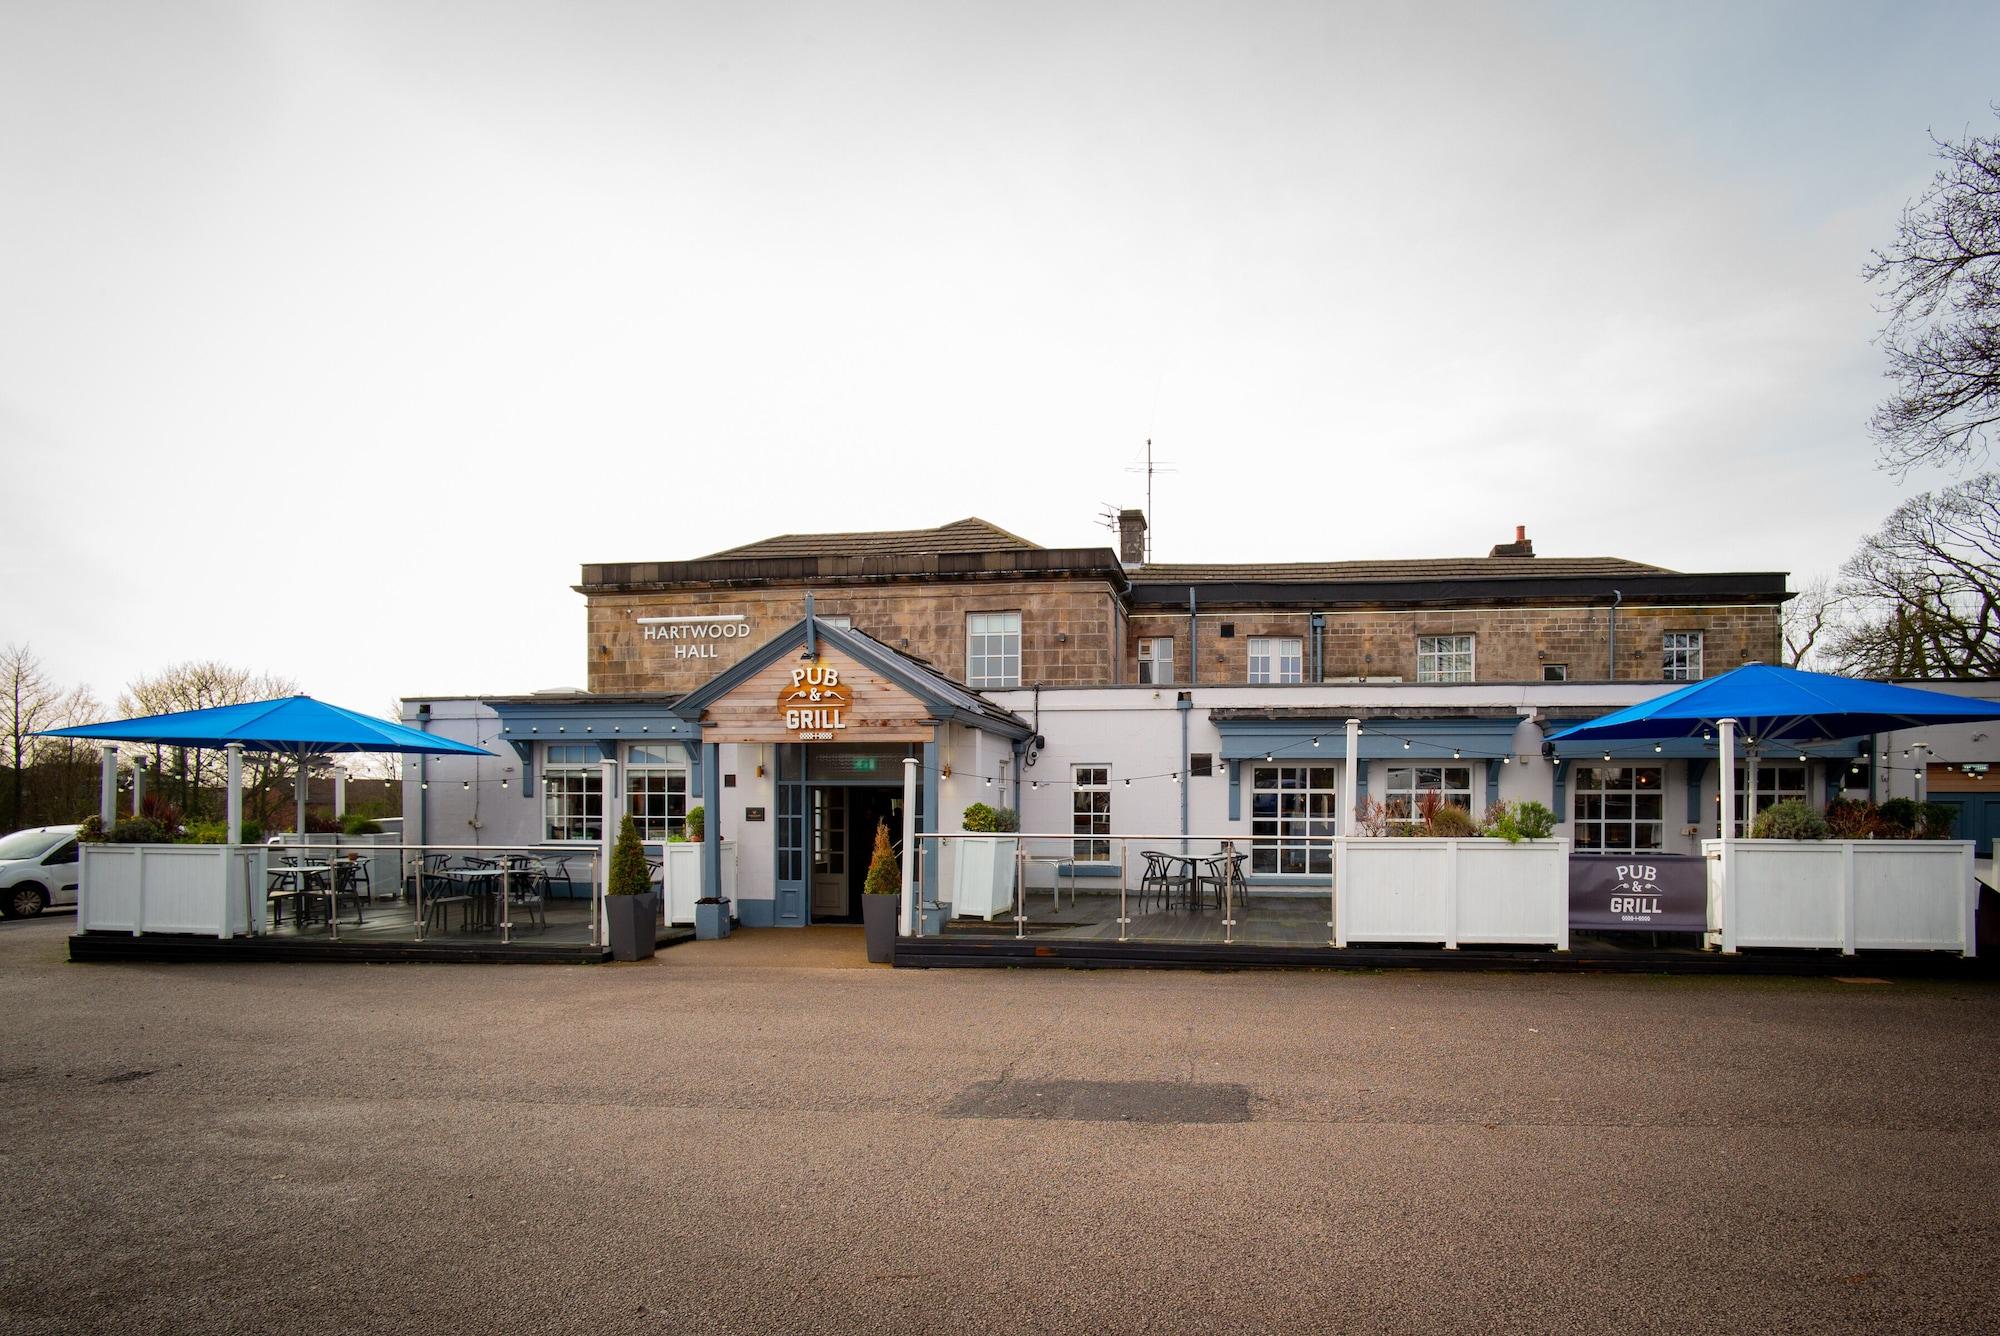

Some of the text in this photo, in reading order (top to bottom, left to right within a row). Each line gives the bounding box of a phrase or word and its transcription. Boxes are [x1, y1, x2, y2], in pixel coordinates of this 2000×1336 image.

[644, 624, 750, 640] HARTWOOD
[675, 644, 718, 658] HALL
[791, 667, 839, 687] PUB
[809, 687, 821, 702] &
[786, 709, 846, 729] GRILL
[1615, 865, 1657, 881] PUB
[1632, 880, 1643, 892] &
[1610, 897, 1662, 913] GRILL
